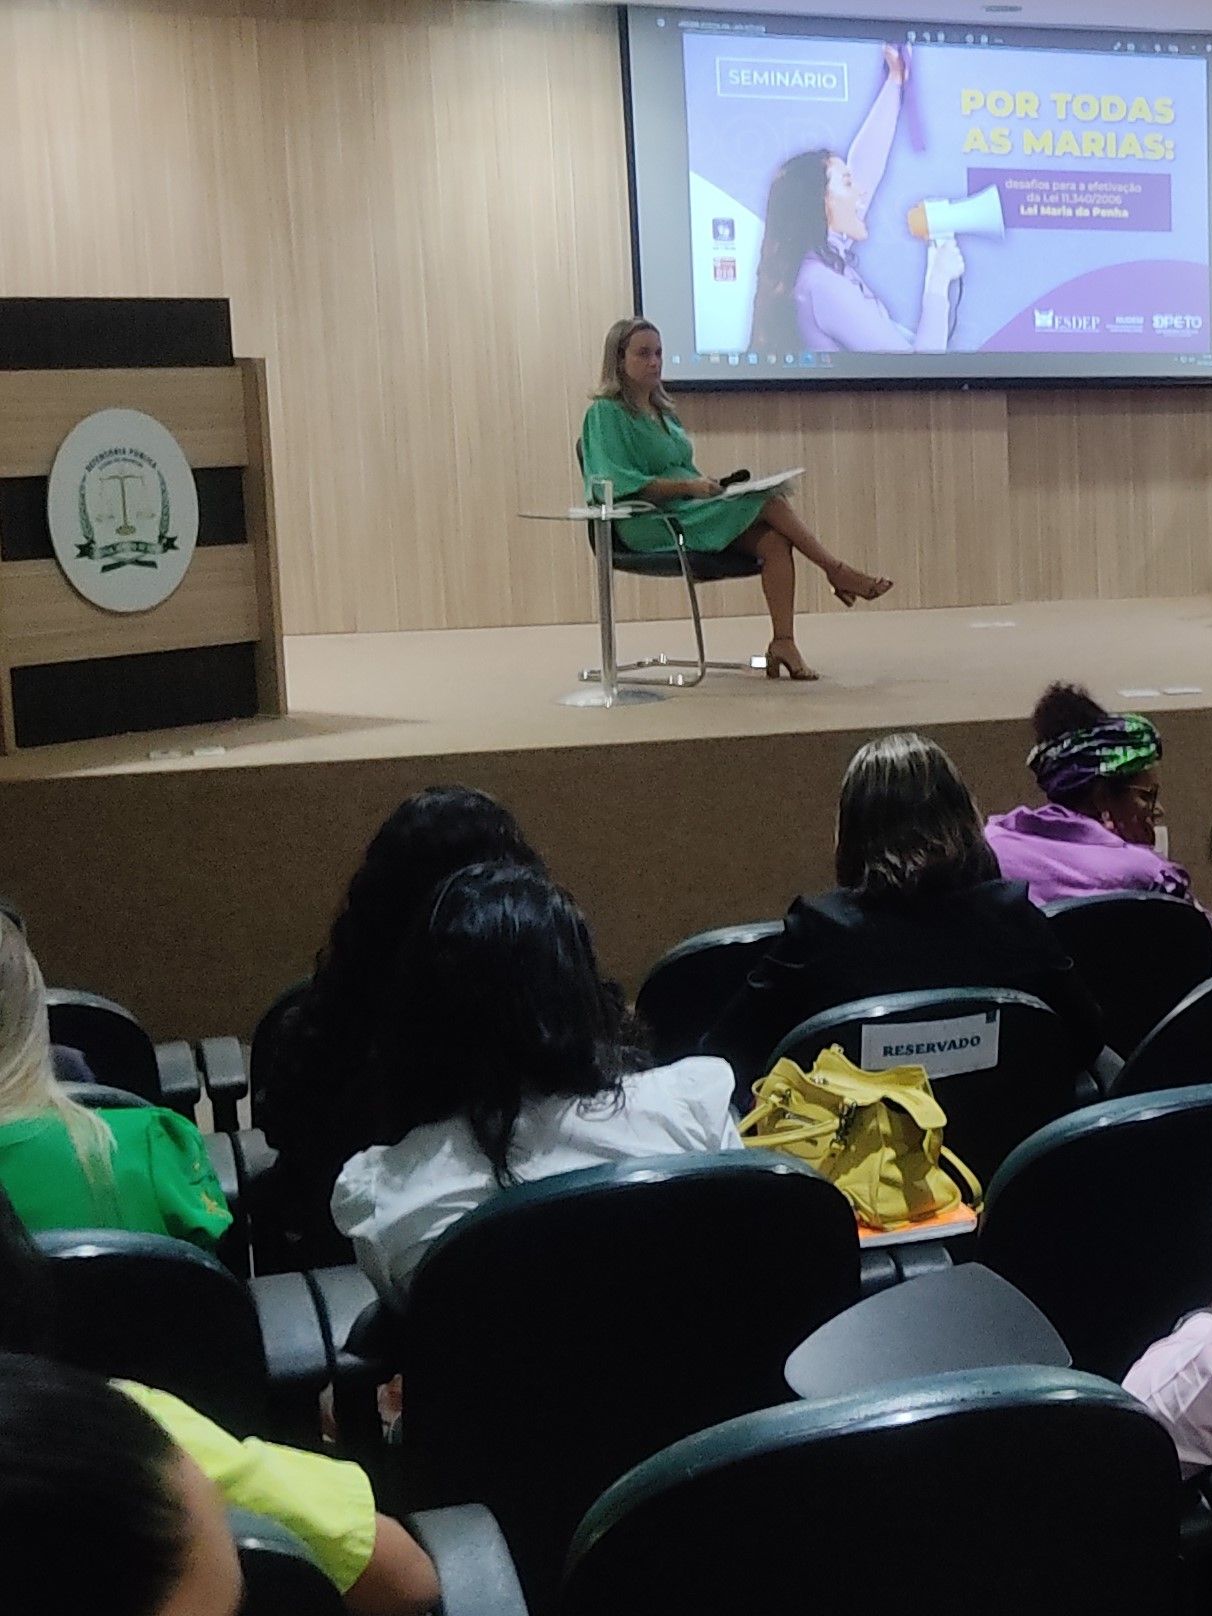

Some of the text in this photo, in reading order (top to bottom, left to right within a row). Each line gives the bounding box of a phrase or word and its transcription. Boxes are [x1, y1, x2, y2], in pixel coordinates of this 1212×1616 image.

[729, 68, 837, 89] SEMINÁRIO
[961, 88, 1175, 124] POR TODAS
[963, 127, 1175, 160] AS MARIAS:
[1020, 204, 1038, 216] Lei
[1040, 205, 1073, 217] Maria
[1092, 206, 1129, 218] Penha
[1054, 315, 1100, 329] ESDEP
[882, 1035, 981, 1057] RESERVADO
